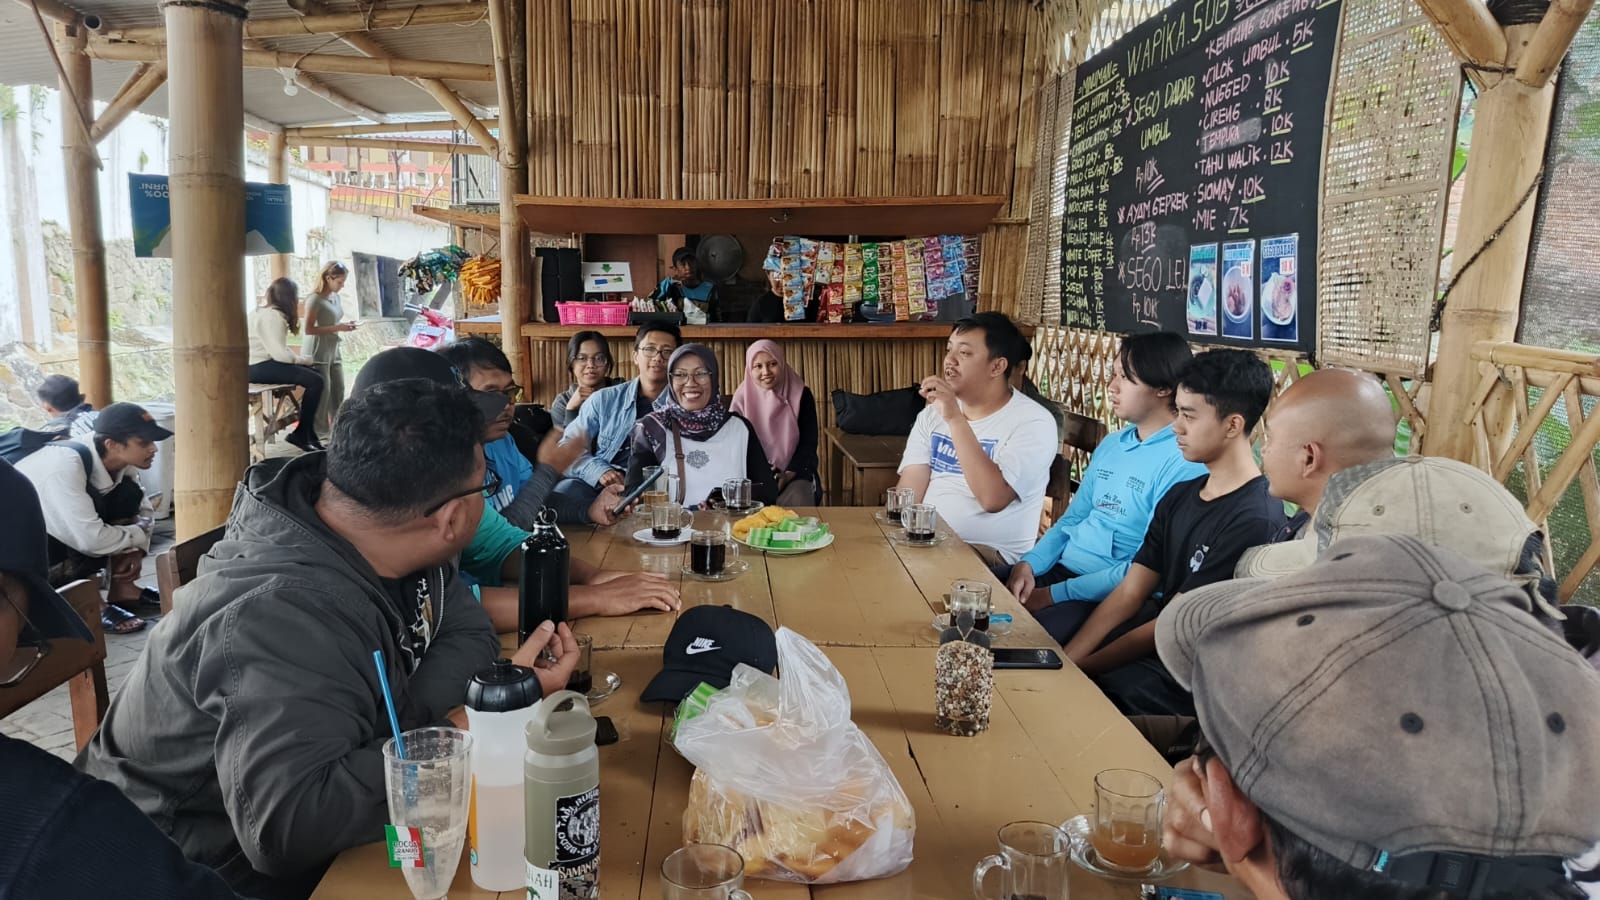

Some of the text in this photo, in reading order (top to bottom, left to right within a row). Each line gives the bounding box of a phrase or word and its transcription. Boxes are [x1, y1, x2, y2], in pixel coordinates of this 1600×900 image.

[1205, 17, 1316, 87] CILOK UMBUL 5K
[1265, 60, 1290, 86] 10K
[1132, 76, 1195, 126] SEGO DADAR
[1263, 88, 1283, 110] 8K
[1271, 112, 1294, 133] 10K
[1199, 152, 1224, 176] TAHU
[1271, 140, 1294, 160] 12K
[1197, 174, 1265, 205] SIOMAY 10K
[1126, 192, 1189, 224] AYAM GEPREK
[1196, 206, 1249, 231] MIE 7K
[1127, 256, 1188, 292] SEGO LEL
